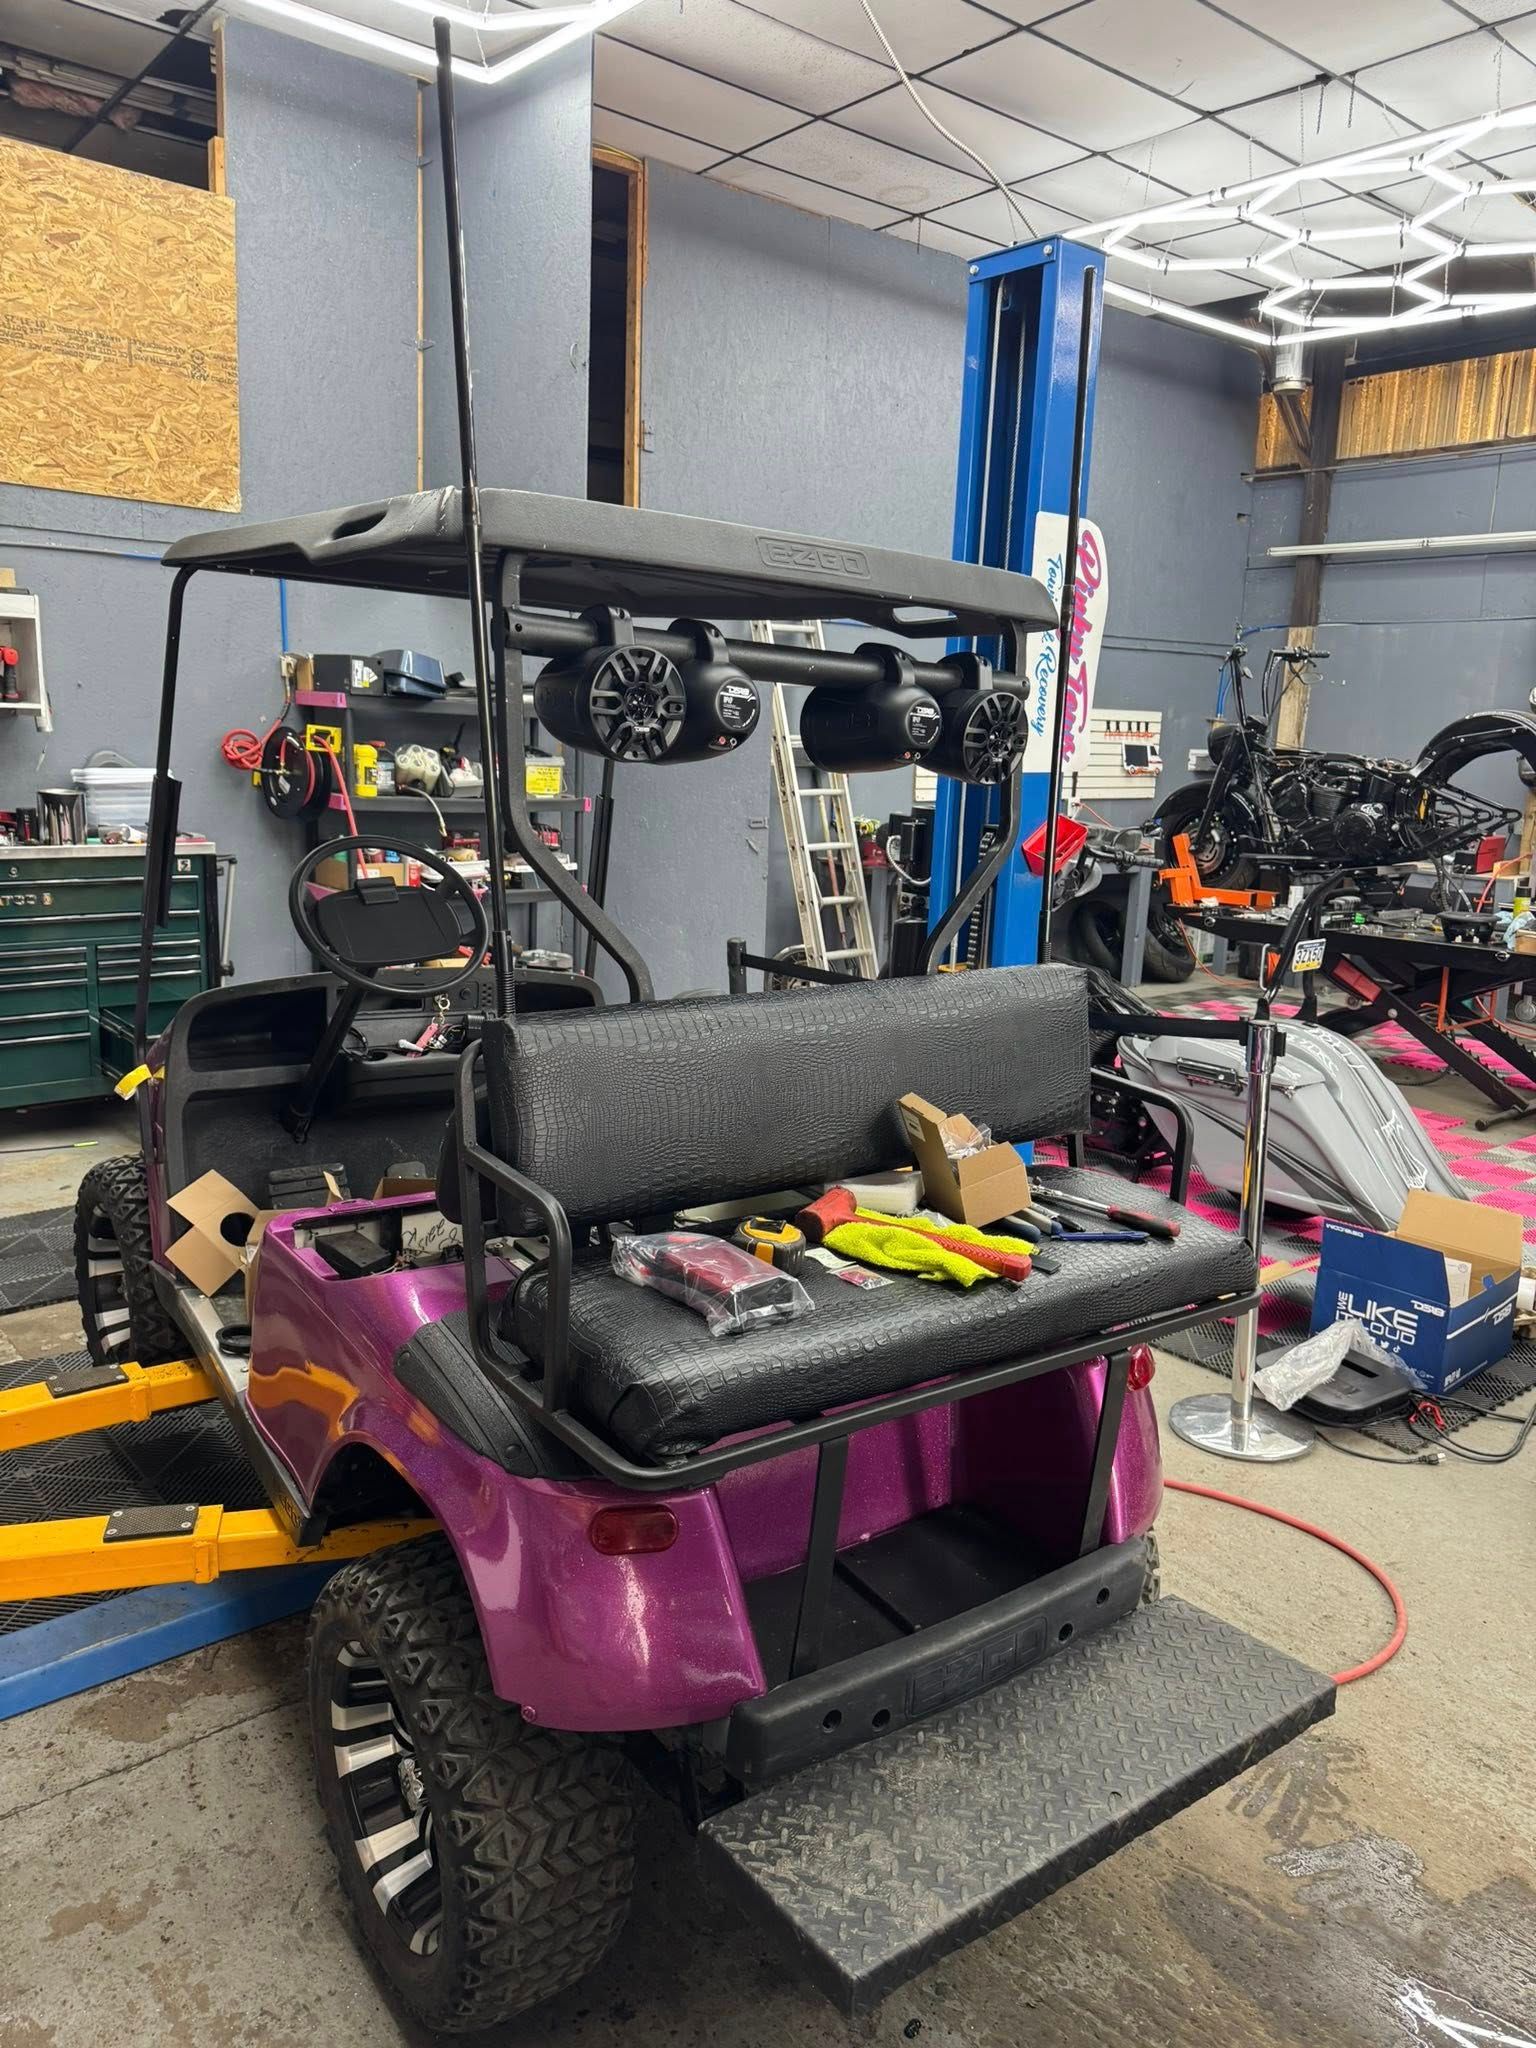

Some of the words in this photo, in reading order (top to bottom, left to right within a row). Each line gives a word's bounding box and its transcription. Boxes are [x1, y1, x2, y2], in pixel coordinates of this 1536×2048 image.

[1046, 553, 1065, 602] Towi
[1031, 646, 1057, 738] Recovery
[1348, 1293, 1419, 1335] LIKE
